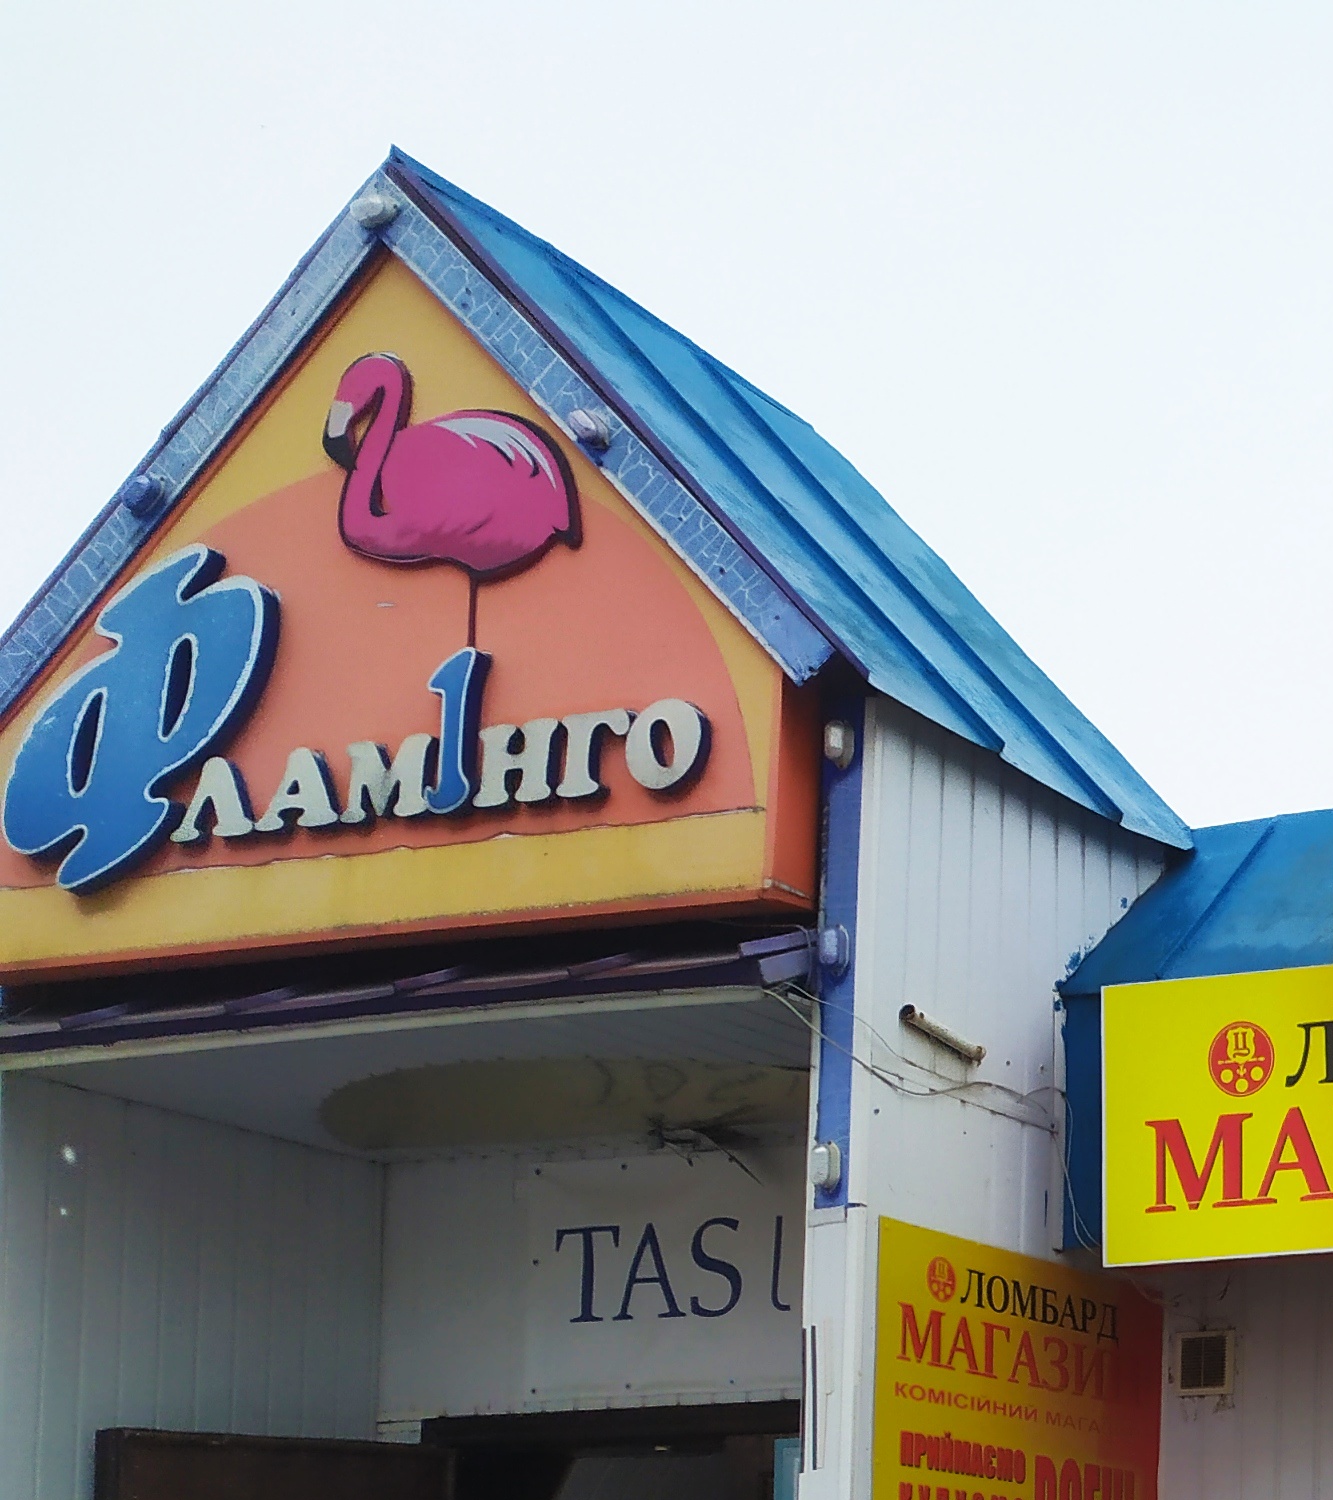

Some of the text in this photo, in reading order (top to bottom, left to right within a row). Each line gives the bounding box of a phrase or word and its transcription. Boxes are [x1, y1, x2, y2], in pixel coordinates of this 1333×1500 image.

[960, 1268, 1119, 1344] ЛОМБАРД
[894, 1381, 1038, 1422] КОМІСІЙНИЙ
[900, 1430, 1026, 1484] ПРИЙМАЄМО
